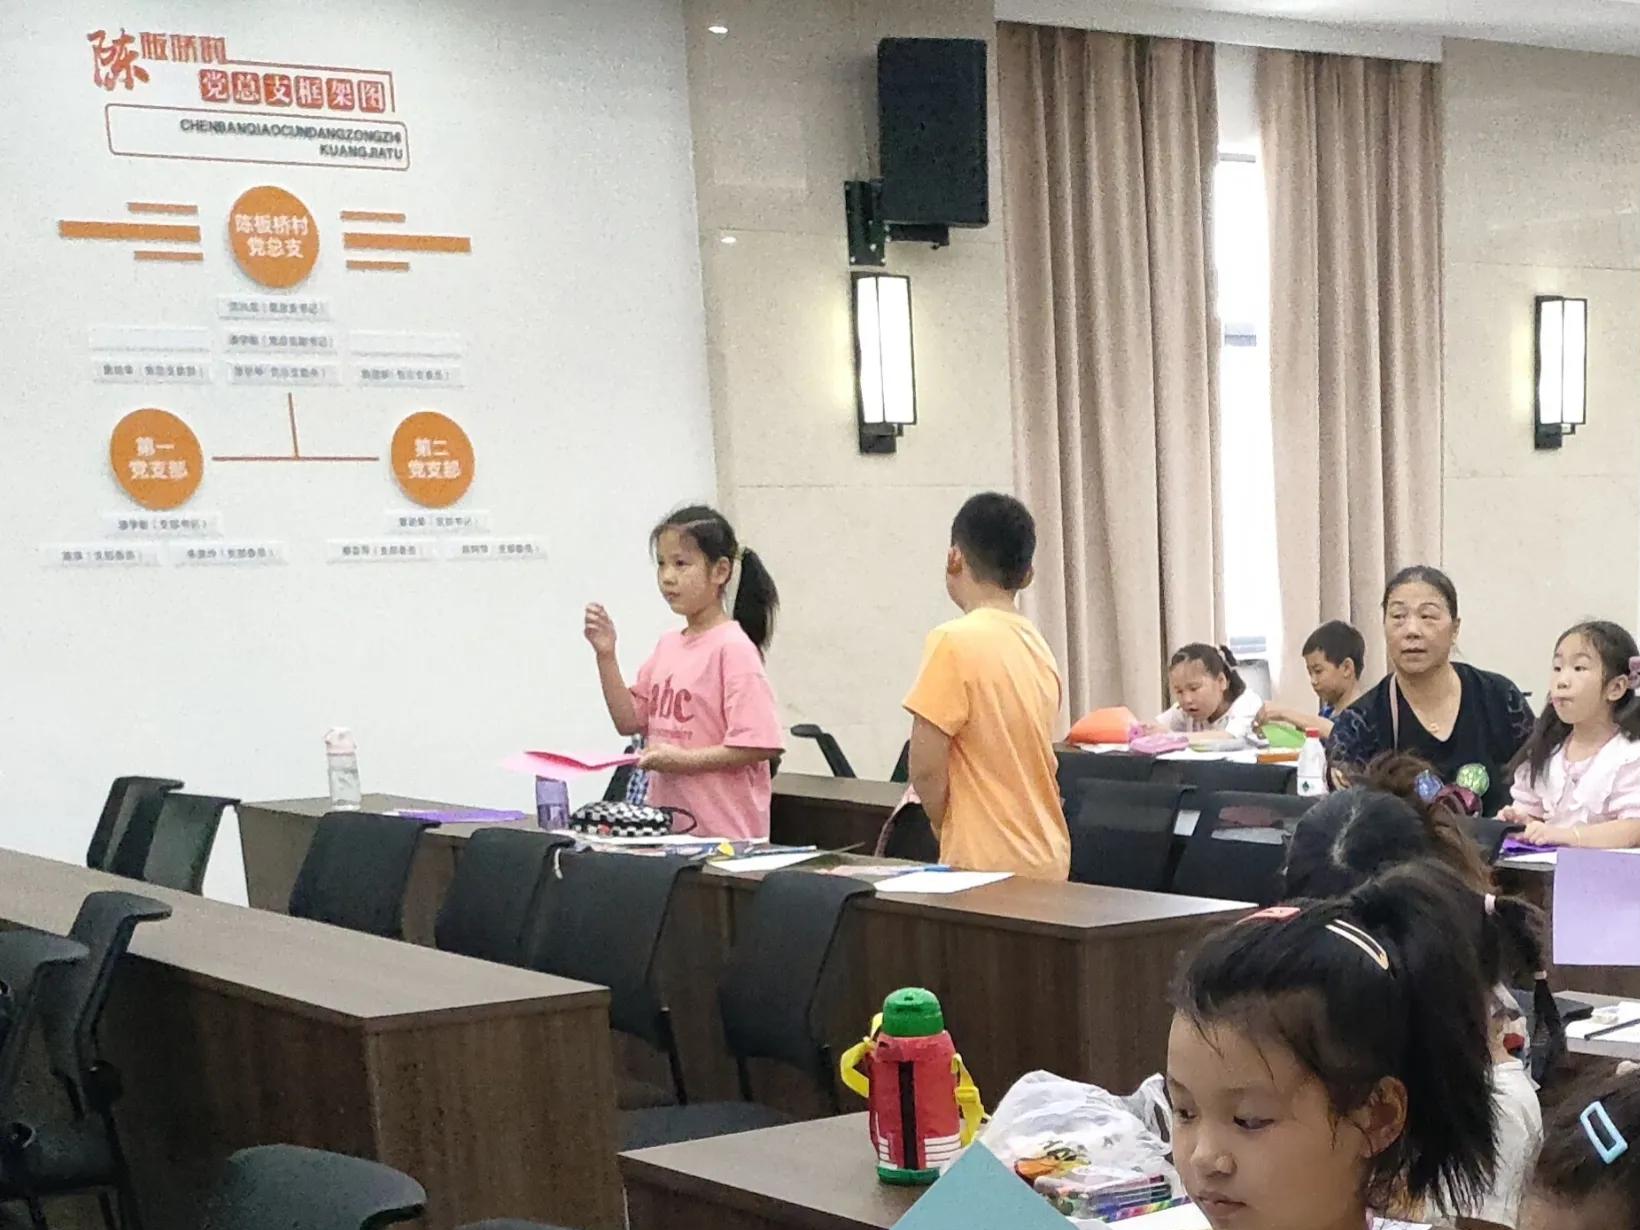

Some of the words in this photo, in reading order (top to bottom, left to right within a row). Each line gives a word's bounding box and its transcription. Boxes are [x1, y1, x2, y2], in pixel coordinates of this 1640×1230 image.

[199, 68, 386, 113] 党总支框架图
[135, 435, 175, 456] 第一
[414, 437, 449, 456] 第二
[129, 458, 188, 481] 党支部
[407, 459, 461, 480] 党支部
